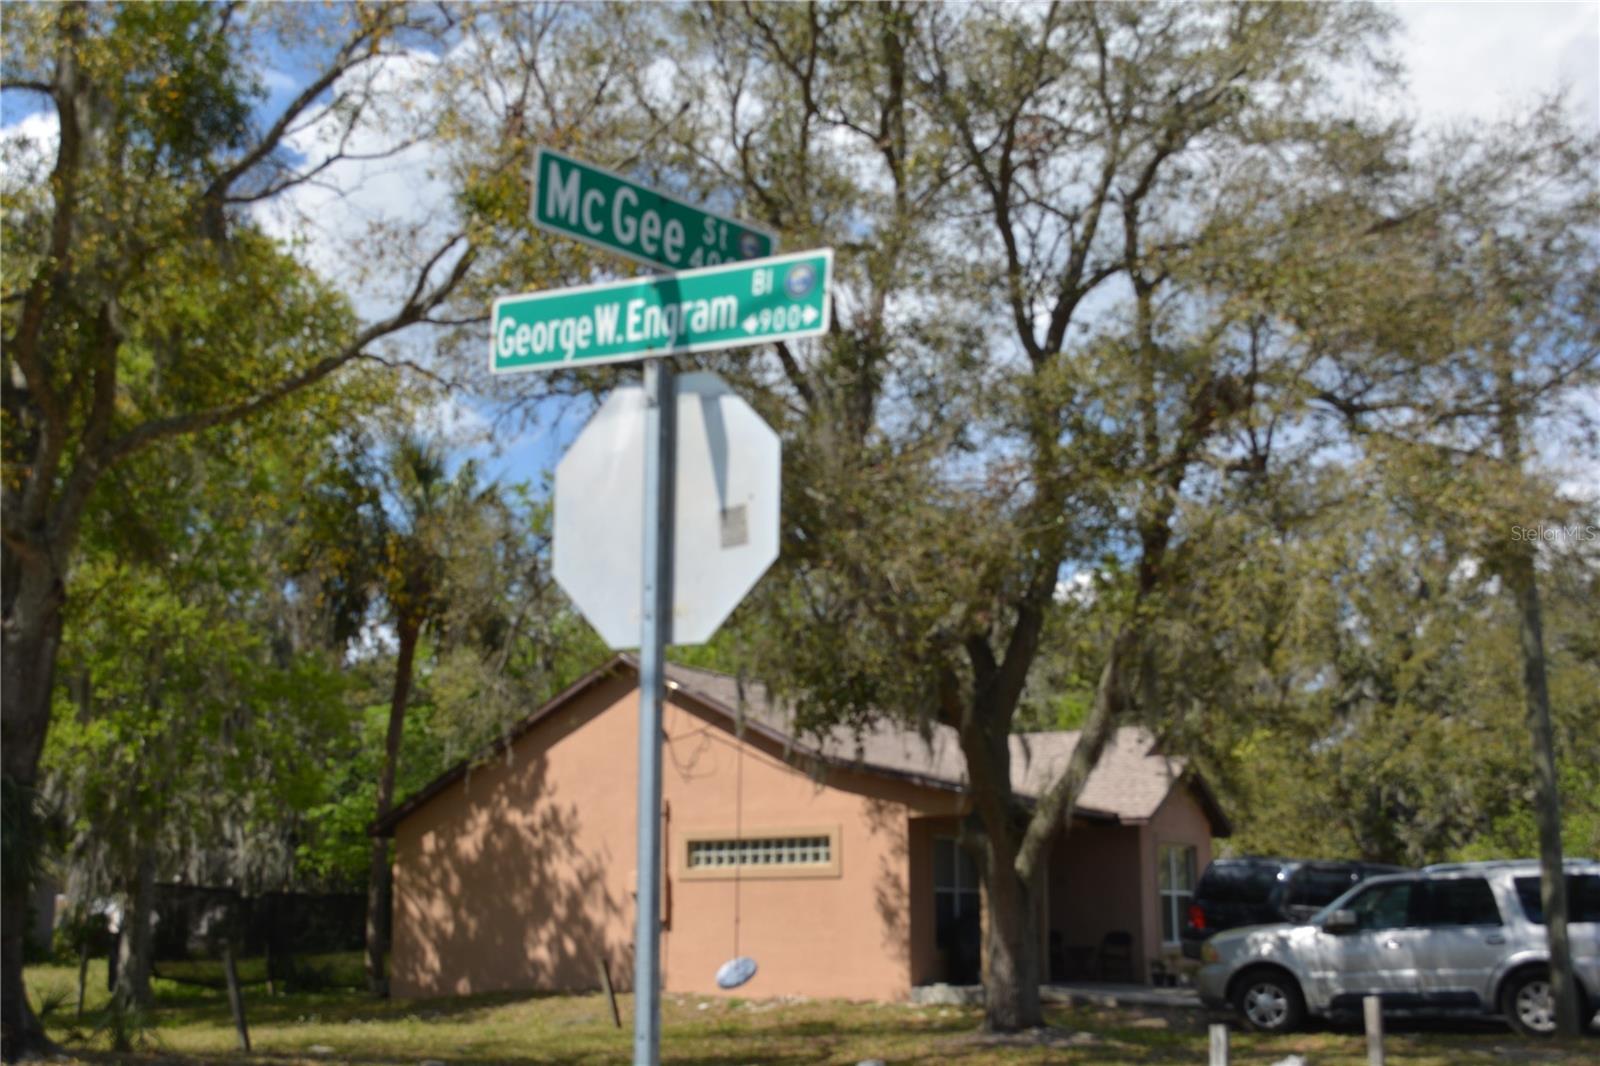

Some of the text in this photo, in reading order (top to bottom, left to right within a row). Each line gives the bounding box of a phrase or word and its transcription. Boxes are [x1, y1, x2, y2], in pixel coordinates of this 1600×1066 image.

[545, 159, 728, 264] McGee St
[759, 304, 801, 333] 900
